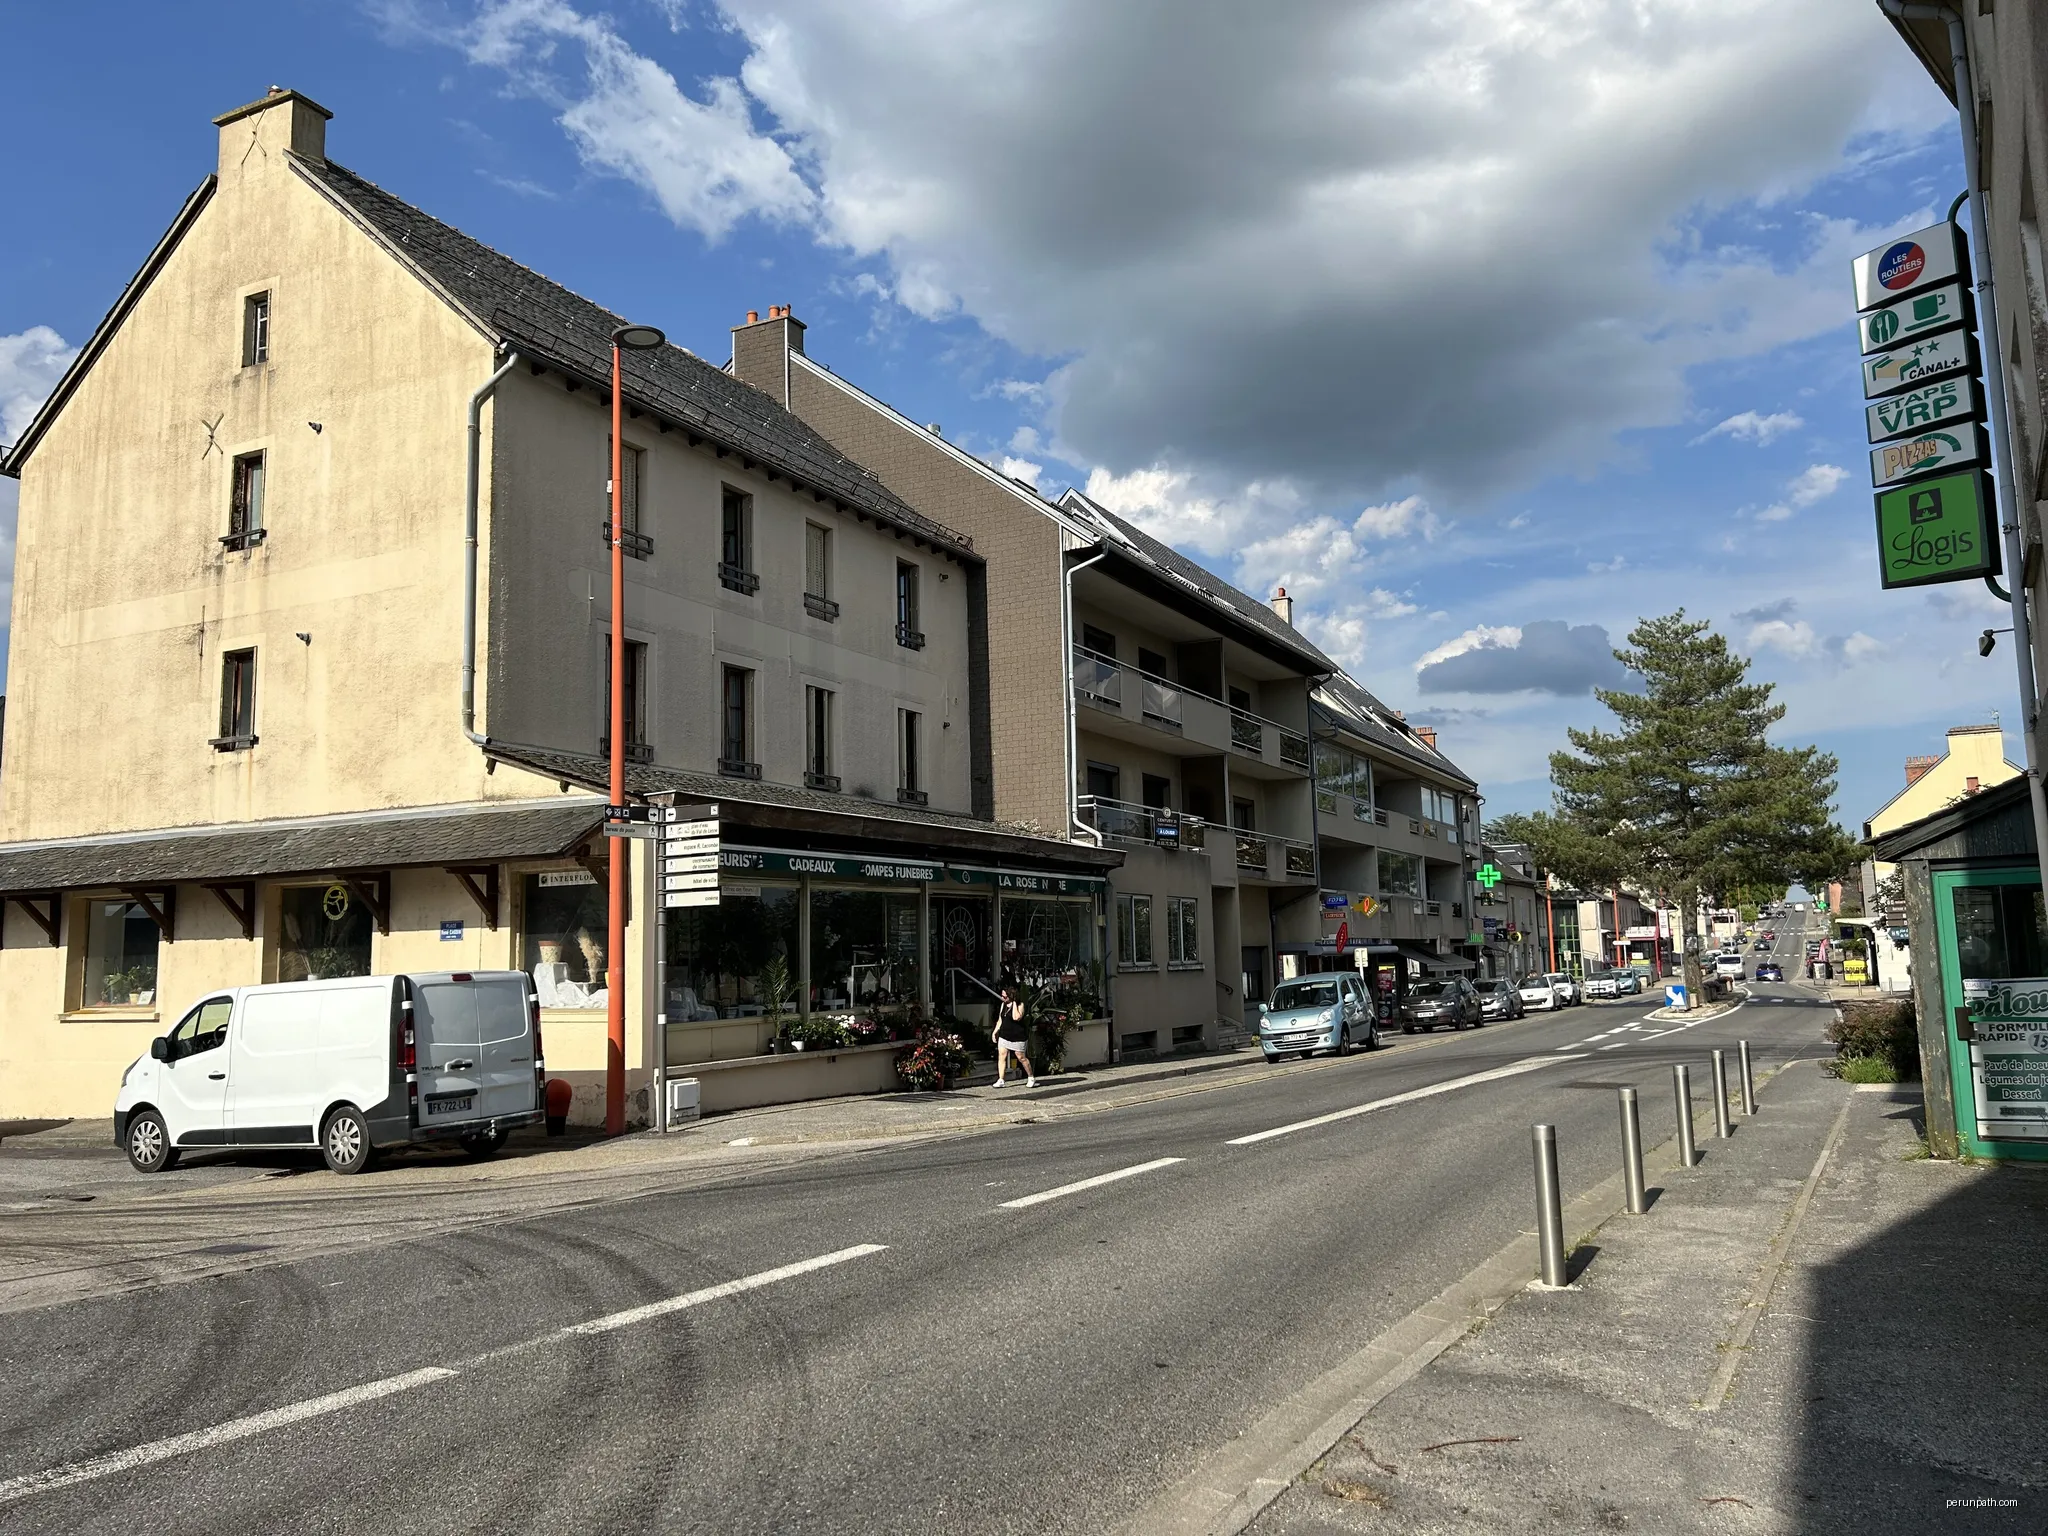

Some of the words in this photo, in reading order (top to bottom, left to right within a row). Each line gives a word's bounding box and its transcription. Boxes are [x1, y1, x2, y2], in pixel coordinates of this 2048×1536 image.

[1892, 252, 1907, 264] LES
[1881, 258, 1922, 280] ROUTIERS
[1909, 357, 1960, 380] CANAL+
[1877, 382, 1956, 416] ETAPE
[1879, 394, 1958, 433] VRP
[1883, 440, 1937, 478] PIZZAS
[1892, 525, 1973, 570] Logis
[789, 858, 836, 873] CADEAUX
[896, 866, 933, 880] FUNEBRES
[999, 875, 1012, 886] LA
[1016, 876, 1037, 888] ROSE
[1989, 1023, 2048, 1031] FORMUL
[1978, 1032, 2026, 1042] RAPIDE
[1984, 1060, 2008, 1070] Pavé
[2010, 1060, 2022, 1070] de
[1980, 1074, 2024, 1087] Légumes
[2025, 1074, 2039, 1085] du
[2002, 1088, 2041, 1099] Dessert
[433, 1100, 466, 1112] FK-722-LX
